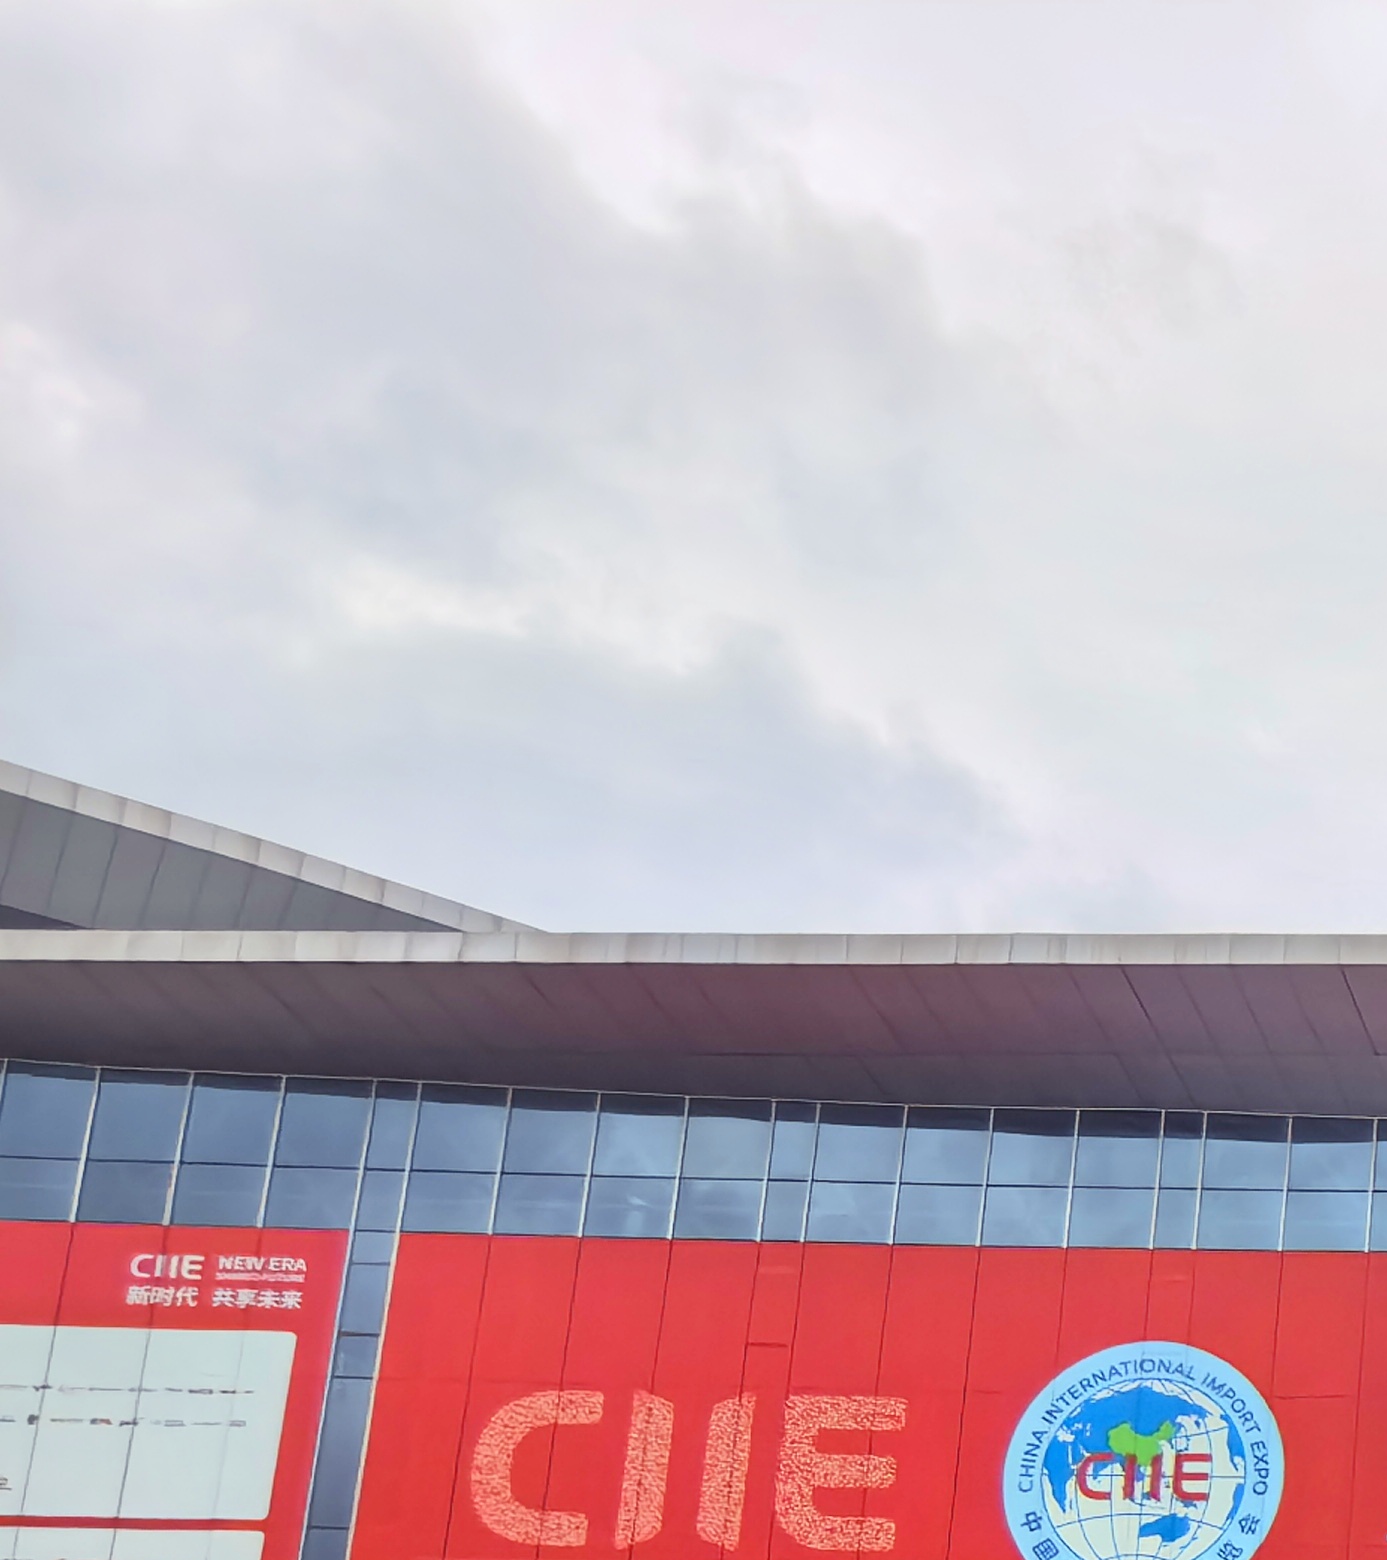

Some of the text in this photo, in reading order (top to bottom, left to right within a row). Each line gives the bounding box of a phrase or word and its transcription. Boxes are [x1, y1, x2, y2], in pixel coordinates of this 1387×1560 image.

[130, 1254, 205, 1280] CIIE
[268, 1258, 307, 1272] ERA
[126, 1285, 303, 1309] 新时代 共享未来
[1018, 1358, 1270, 1496] CHINA INTERNATIONAL IMPORT EXPO
[470, 1389, 909, 1552] CIIE
[1075, 1453, 1213, 1502] CIIE
